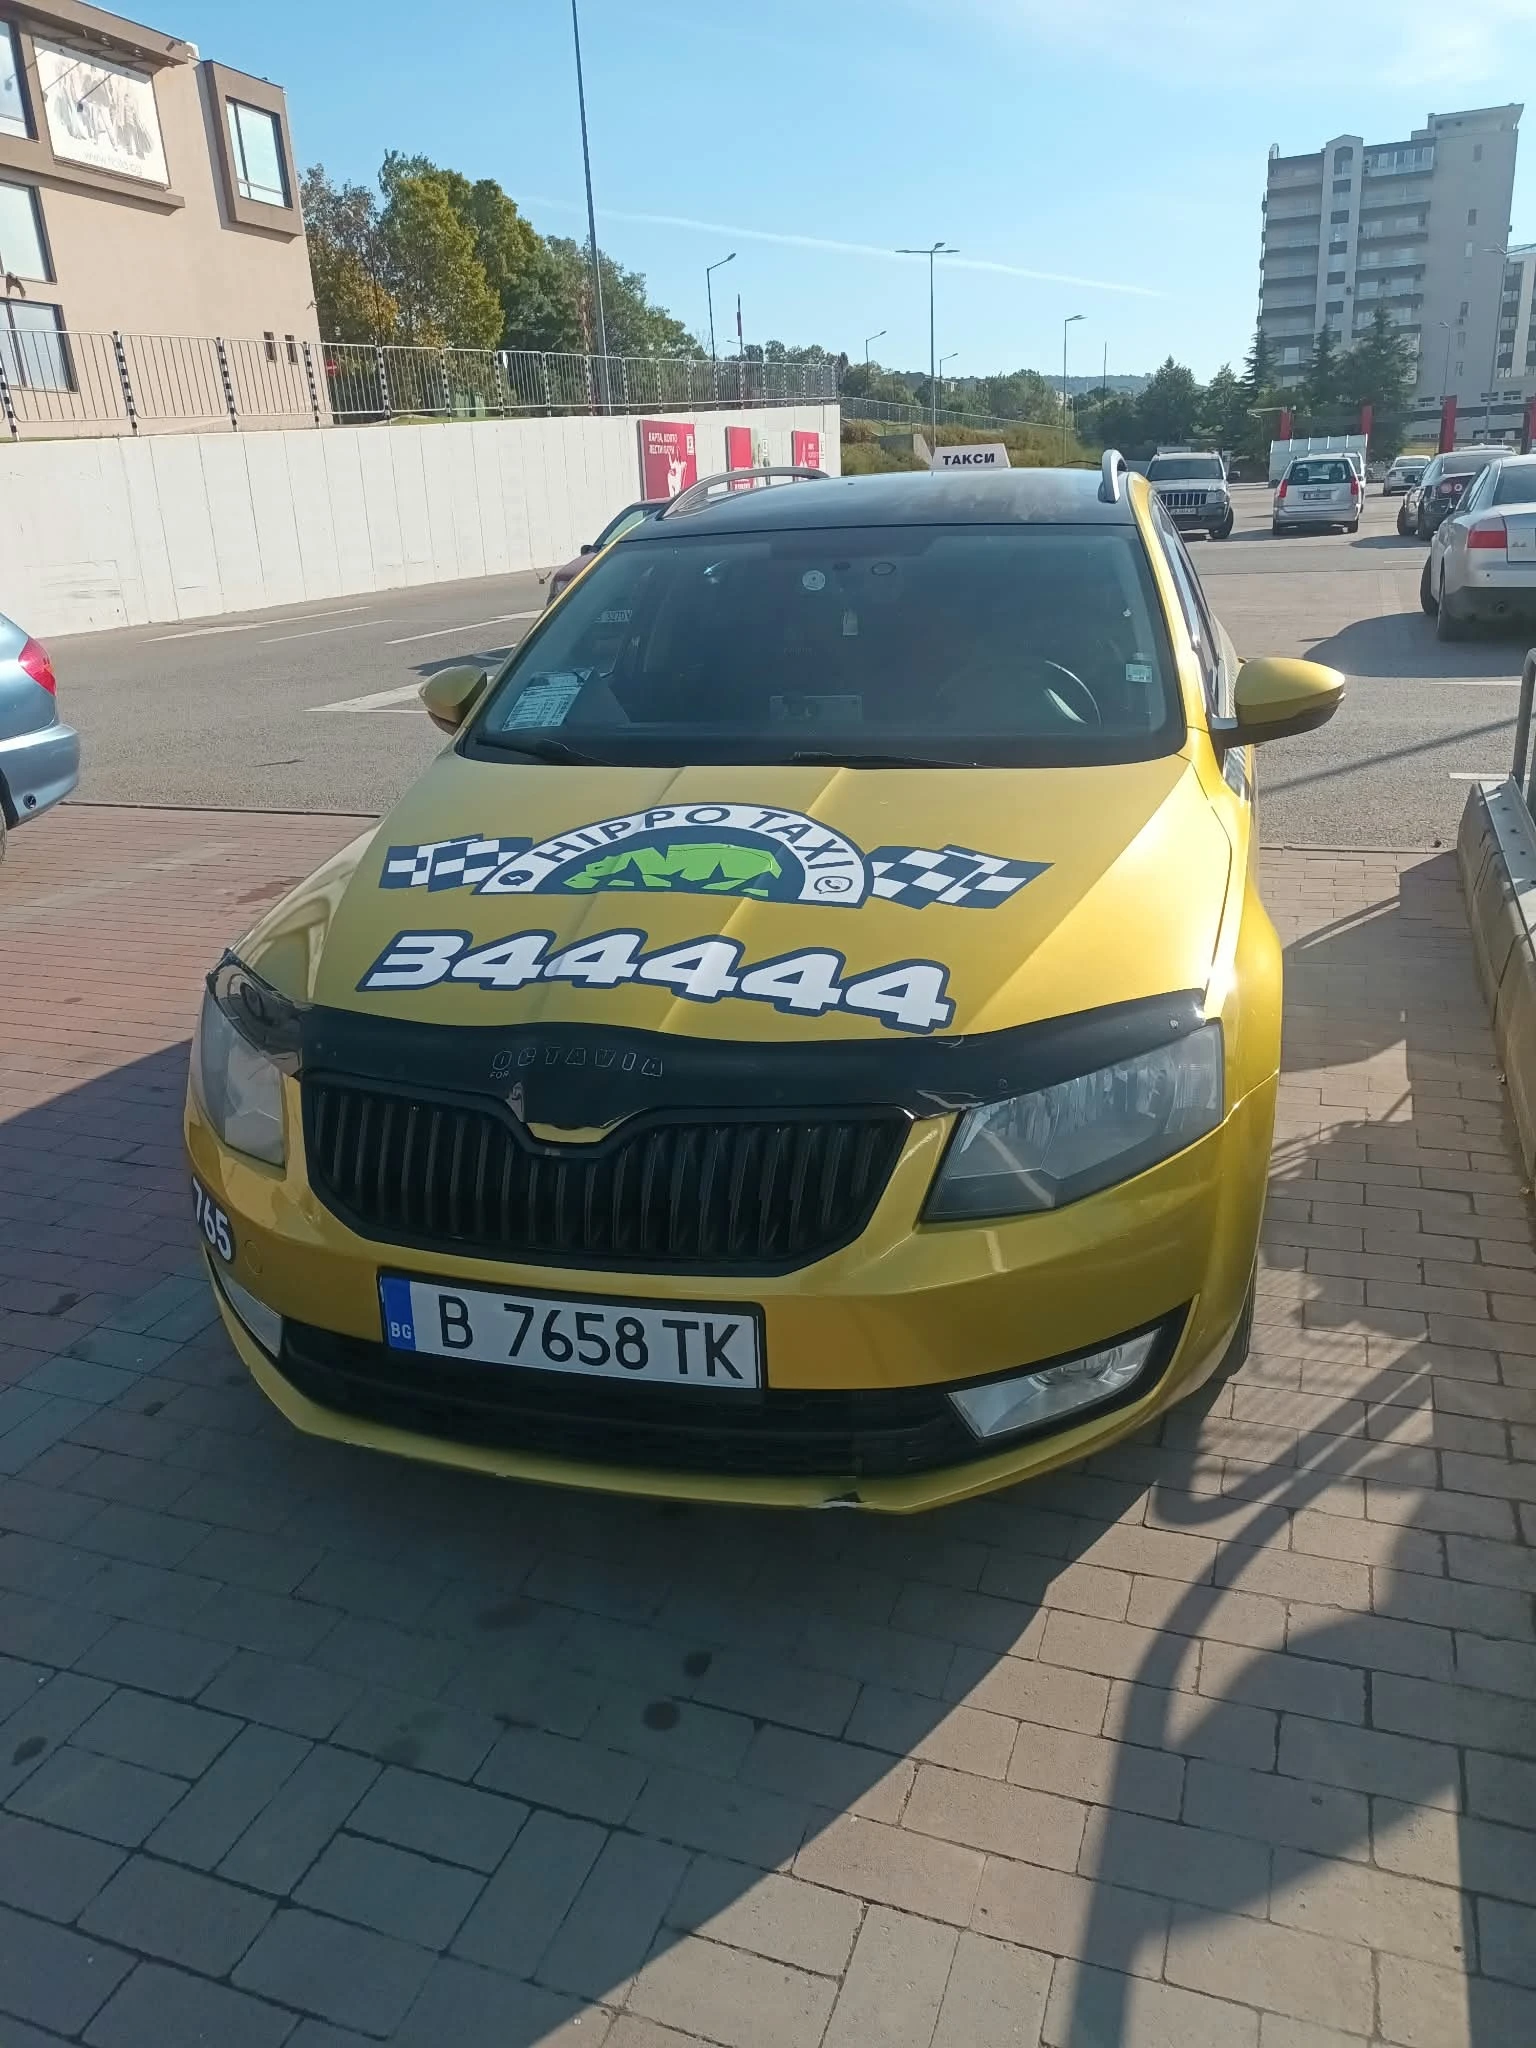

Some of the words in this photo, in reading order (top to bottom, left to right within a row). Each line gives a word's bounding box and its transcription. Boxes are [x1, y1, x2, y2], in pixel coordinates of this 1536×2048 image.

[943, 453, 995, 465] ТАКСИ
[533, 806, 731, 864] HIPPO
[749, 810, 855, 870] TAXI
[363, 932, 953, 1029] 344444
[489, 1070, 509, 1079] FOR
[492, 1047, 663, 1077] OCTAVIA
[193, 1176, 232, 1261] 765
[390, 1321, 412, 1339] BG
[438, 1294, 474, 1349] B
[503, 1303, 649, 1370] 7658
[662, 1319, 744, 1379] TK
